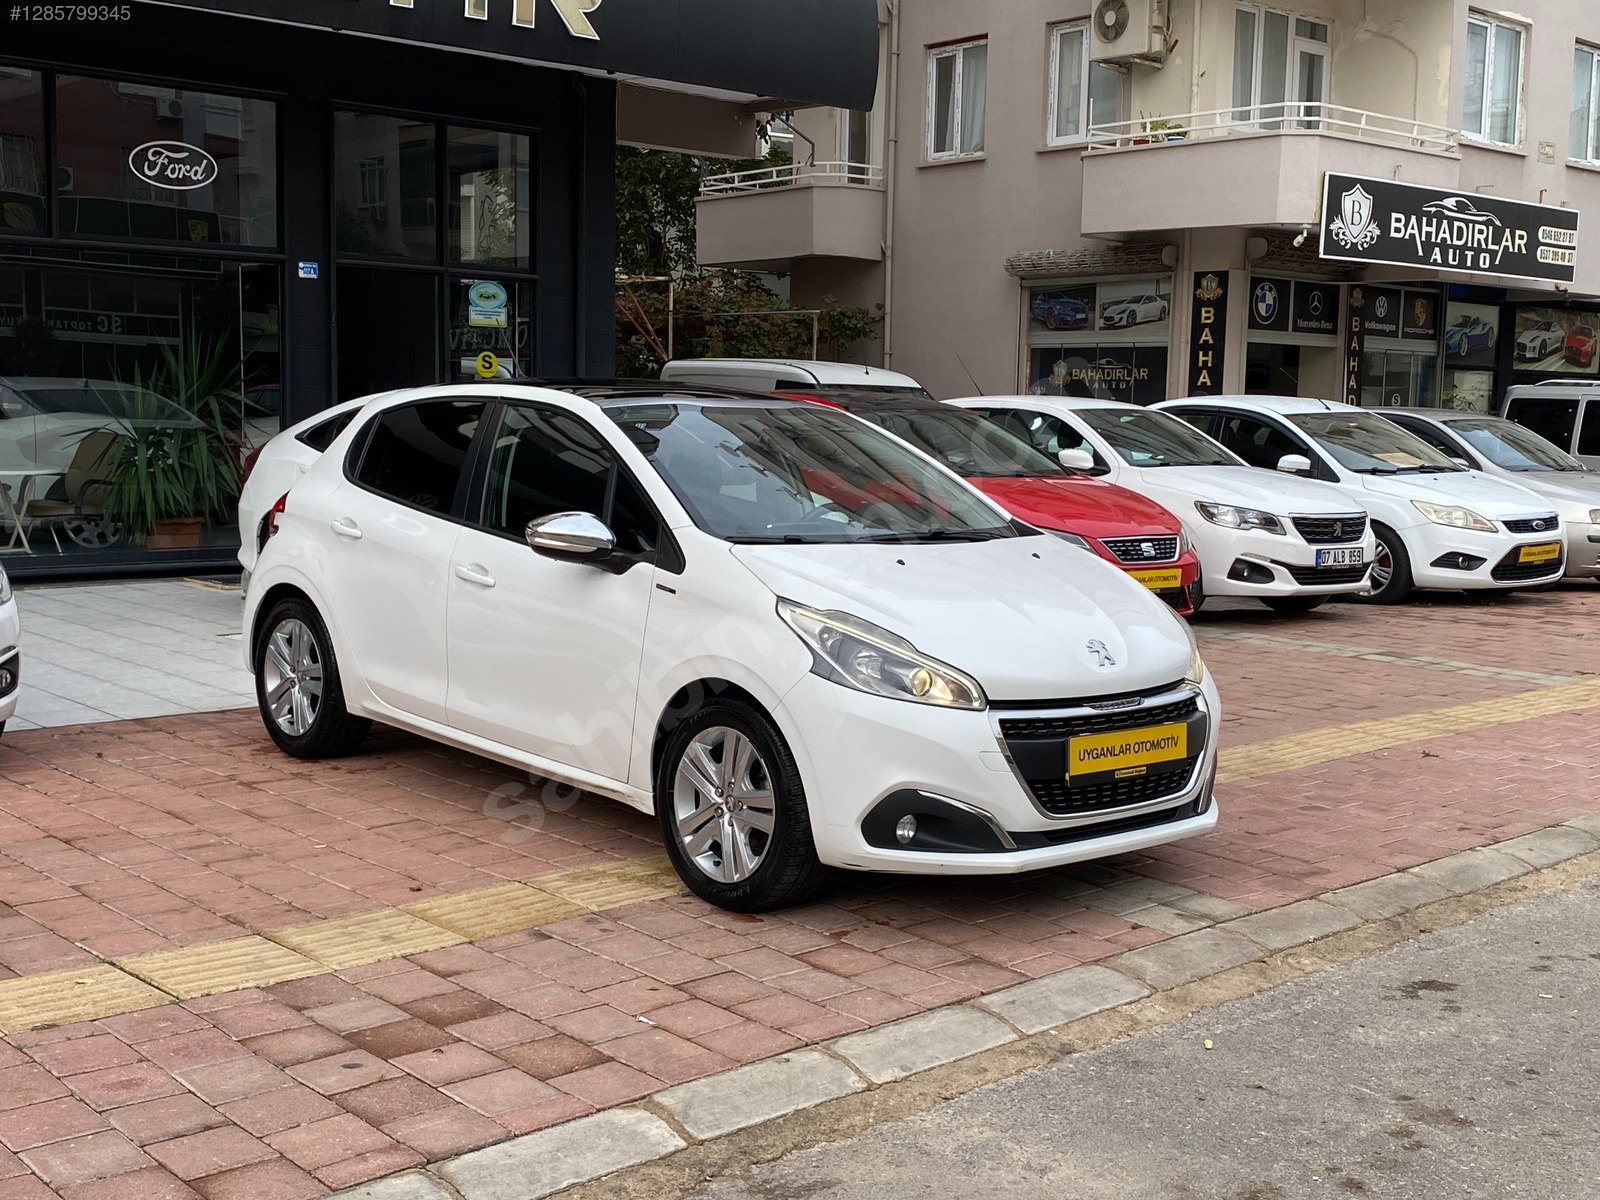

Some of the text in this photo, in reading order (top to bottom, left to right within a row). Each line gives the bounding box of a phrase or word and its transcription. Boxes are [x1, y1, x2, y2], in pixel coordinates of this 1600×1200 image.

[143, 147, 208, 181] Ford
[1350, 199, 1362, 226] B
[1389, 212, 1528, 265] BAHADIRLAR
[1429, 246, 1491, 269] AUTO
[1296, 318, 1333, 330] Mercedes-Benz
[1364, 320, 1396, 333] Volkswagen
[1403, 327, 1434, 335] PORSCHE
[1196, 306, 1215, 386] BAHA
[481, 354, 493, 370] S
[1071, 367, 1149, 387] BAHADIRLAR
[1092, 380, 1127, 389] AUTO
[1321, 549, 1361, 565] 07 ALB 859
[1078, 734, 1180, 762] UYGANLAR OTOMOTİV
